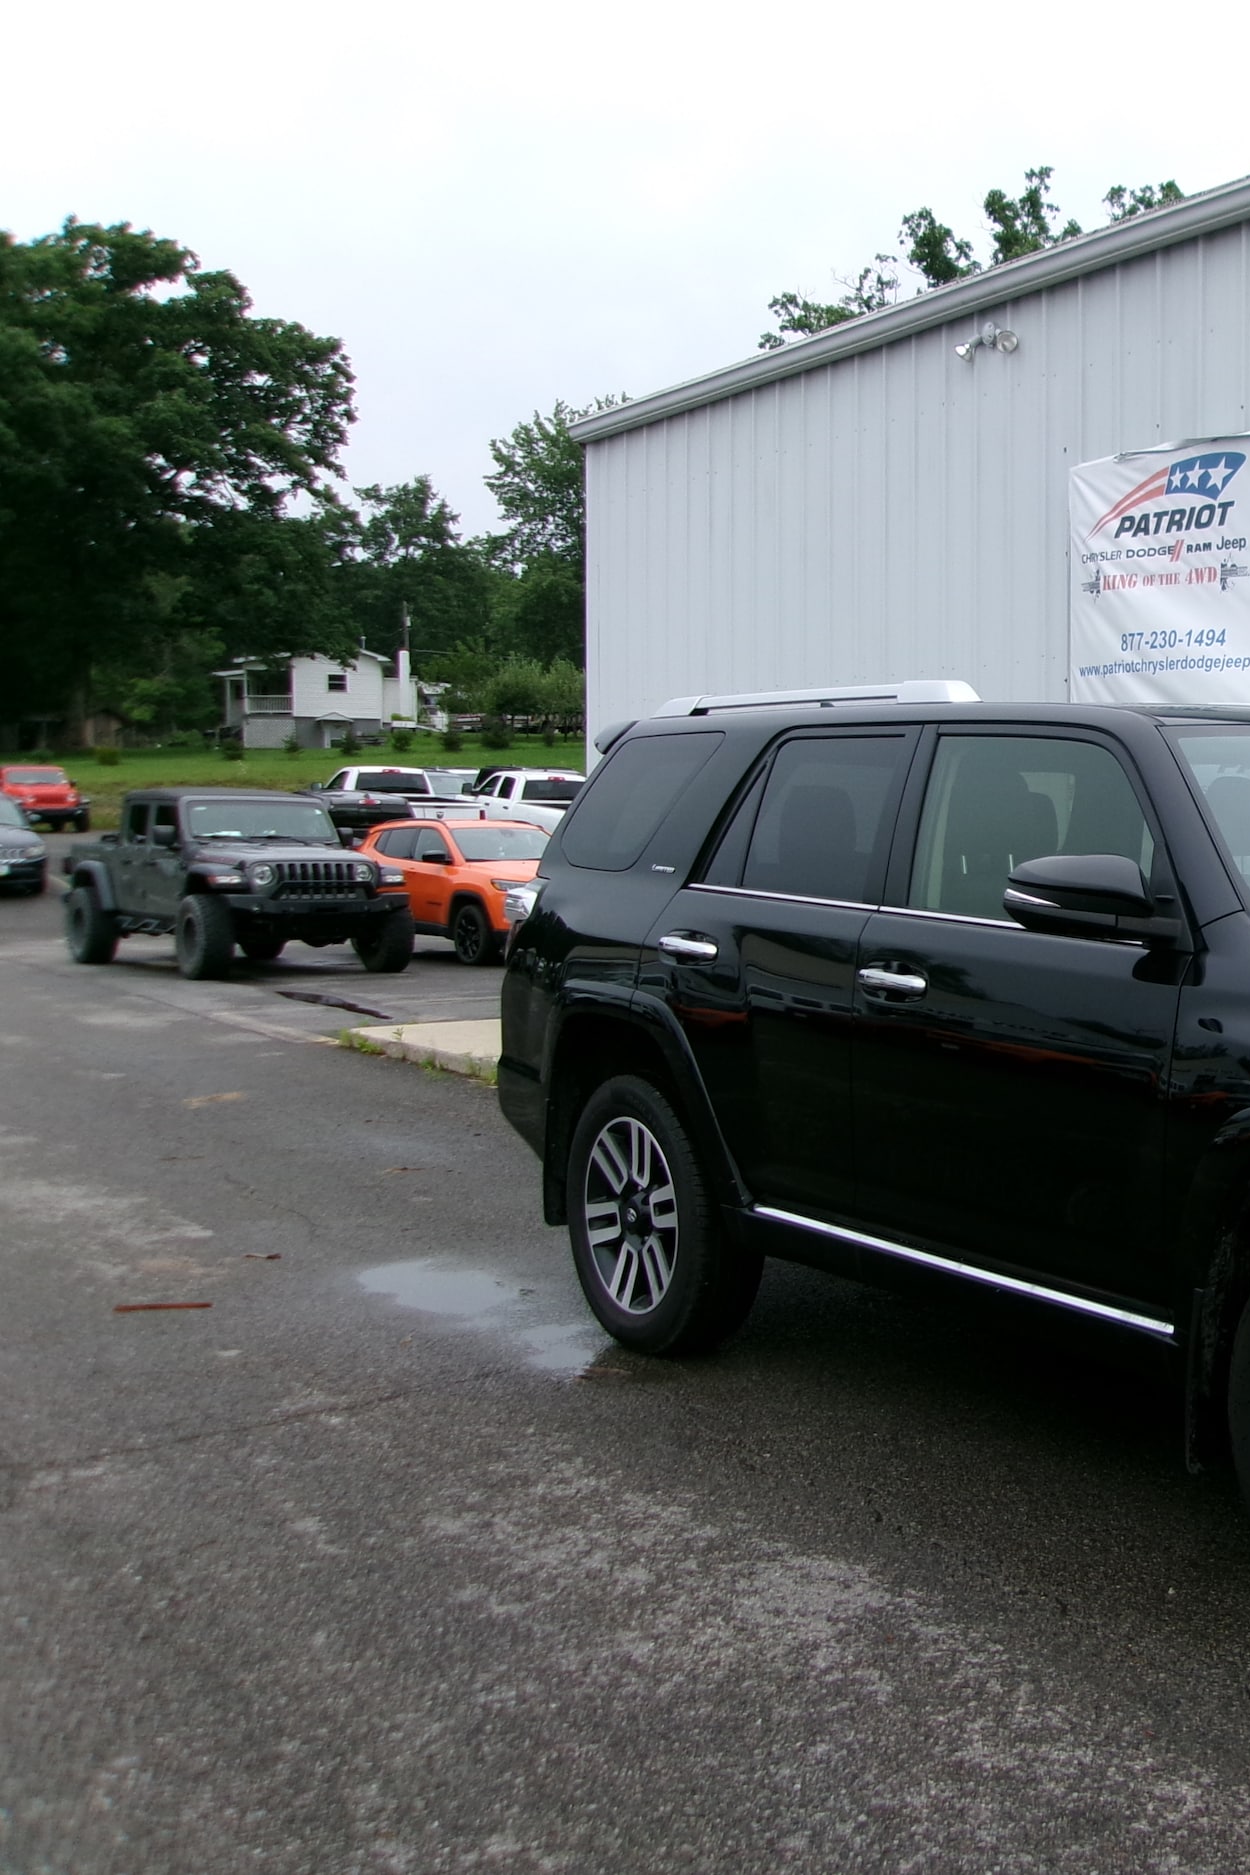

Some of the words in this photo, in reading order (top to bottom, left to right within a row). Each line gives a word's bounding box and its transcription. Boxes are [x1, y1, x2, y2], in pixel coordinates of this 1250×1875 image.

[1114, 500, 1235, 538] PATRIOT
[1081, 550, 1122, 564] CHRYSLER
[1126, 545, 1175, 559] DODGE
[1186, 542, 1212, 554] RAM
[1216, 536, 1246, 551] Jeep
[1102, 573, 1138, 591] KING
[1142, 574, 1157, 587] OF
[1157, 572, 1180, 586] THE
[1185, 566, 1217, 585] 4WD
[1121, 628, 1226, 651] 877-230-1494
